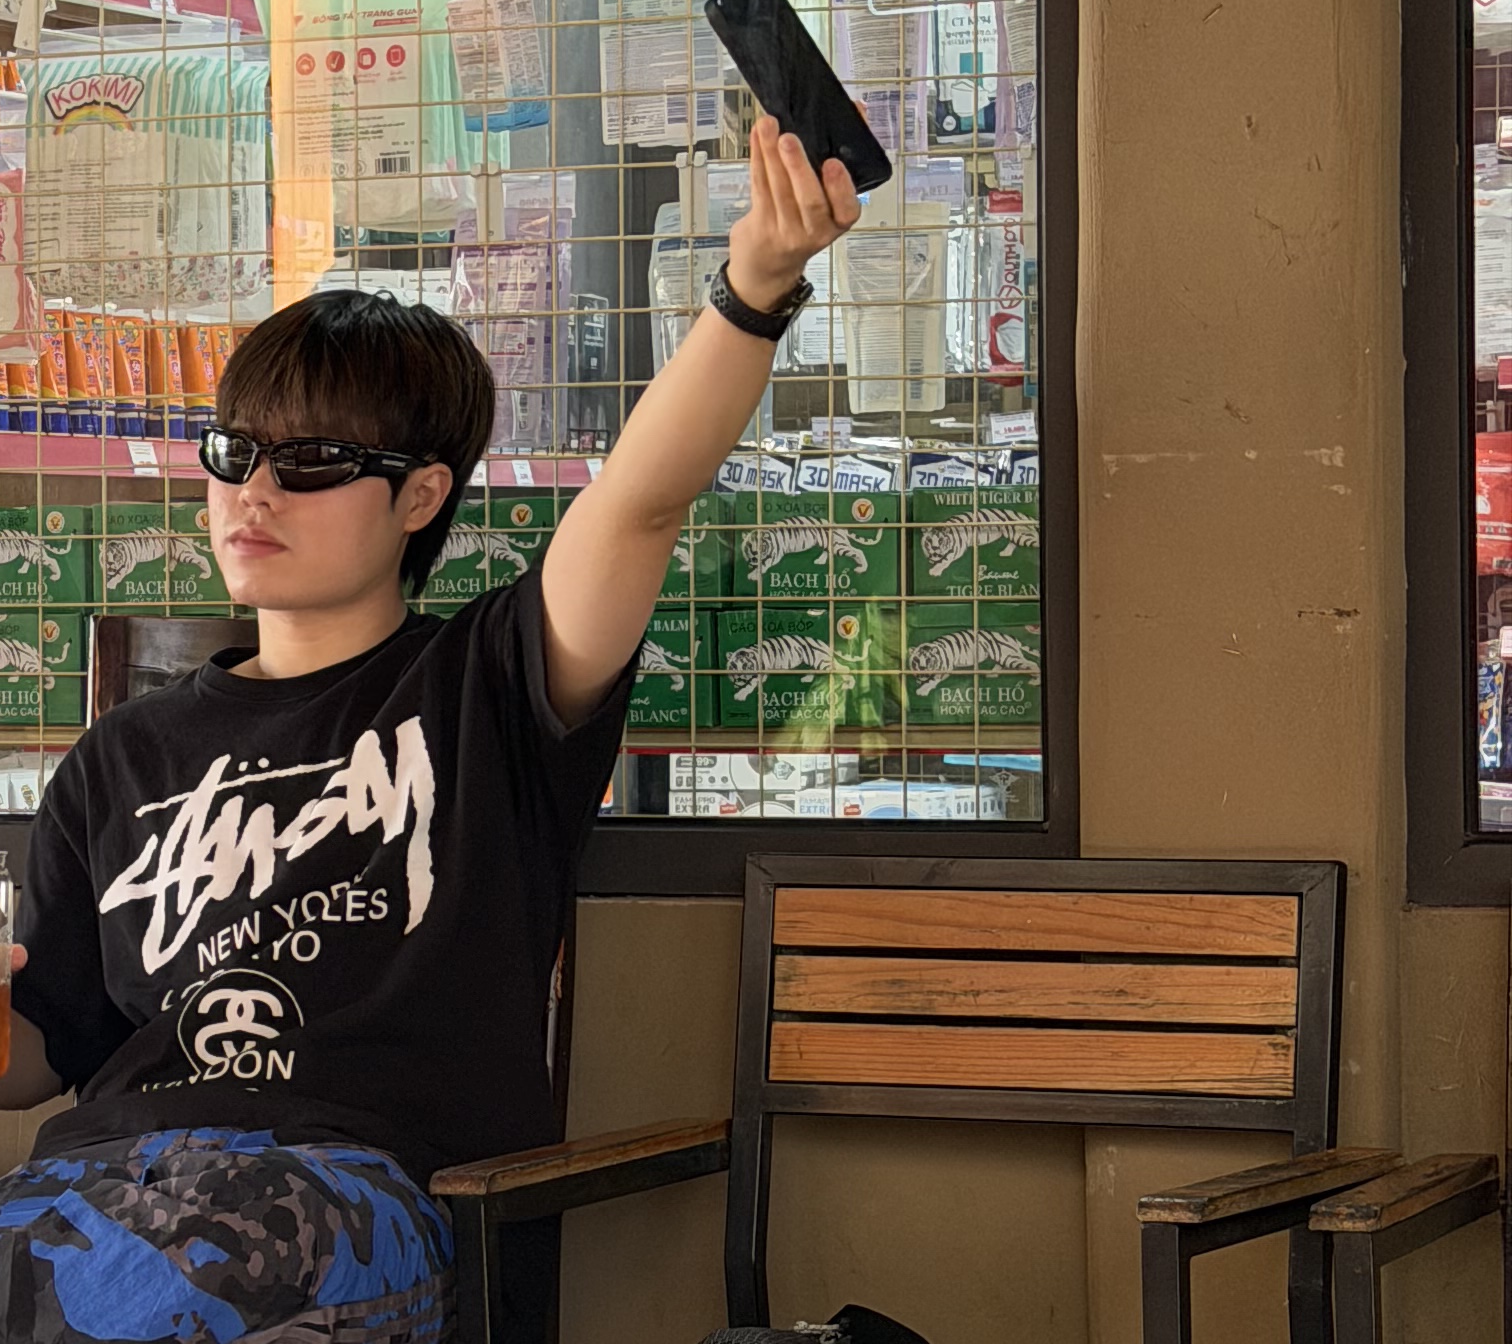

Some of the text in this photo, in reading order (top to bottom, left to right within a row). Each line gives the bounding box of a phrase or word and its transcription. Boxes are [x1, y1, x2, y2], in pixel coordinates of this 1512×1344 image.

[51, 77, 138, 112] KOKIMI
[721, 462, 787, 490] 3D MASK
[803, 465, 887, 493] 3D MASK
[980, 490, 1022, 505] TIGER
[198, 910, 260, 972] NEW
